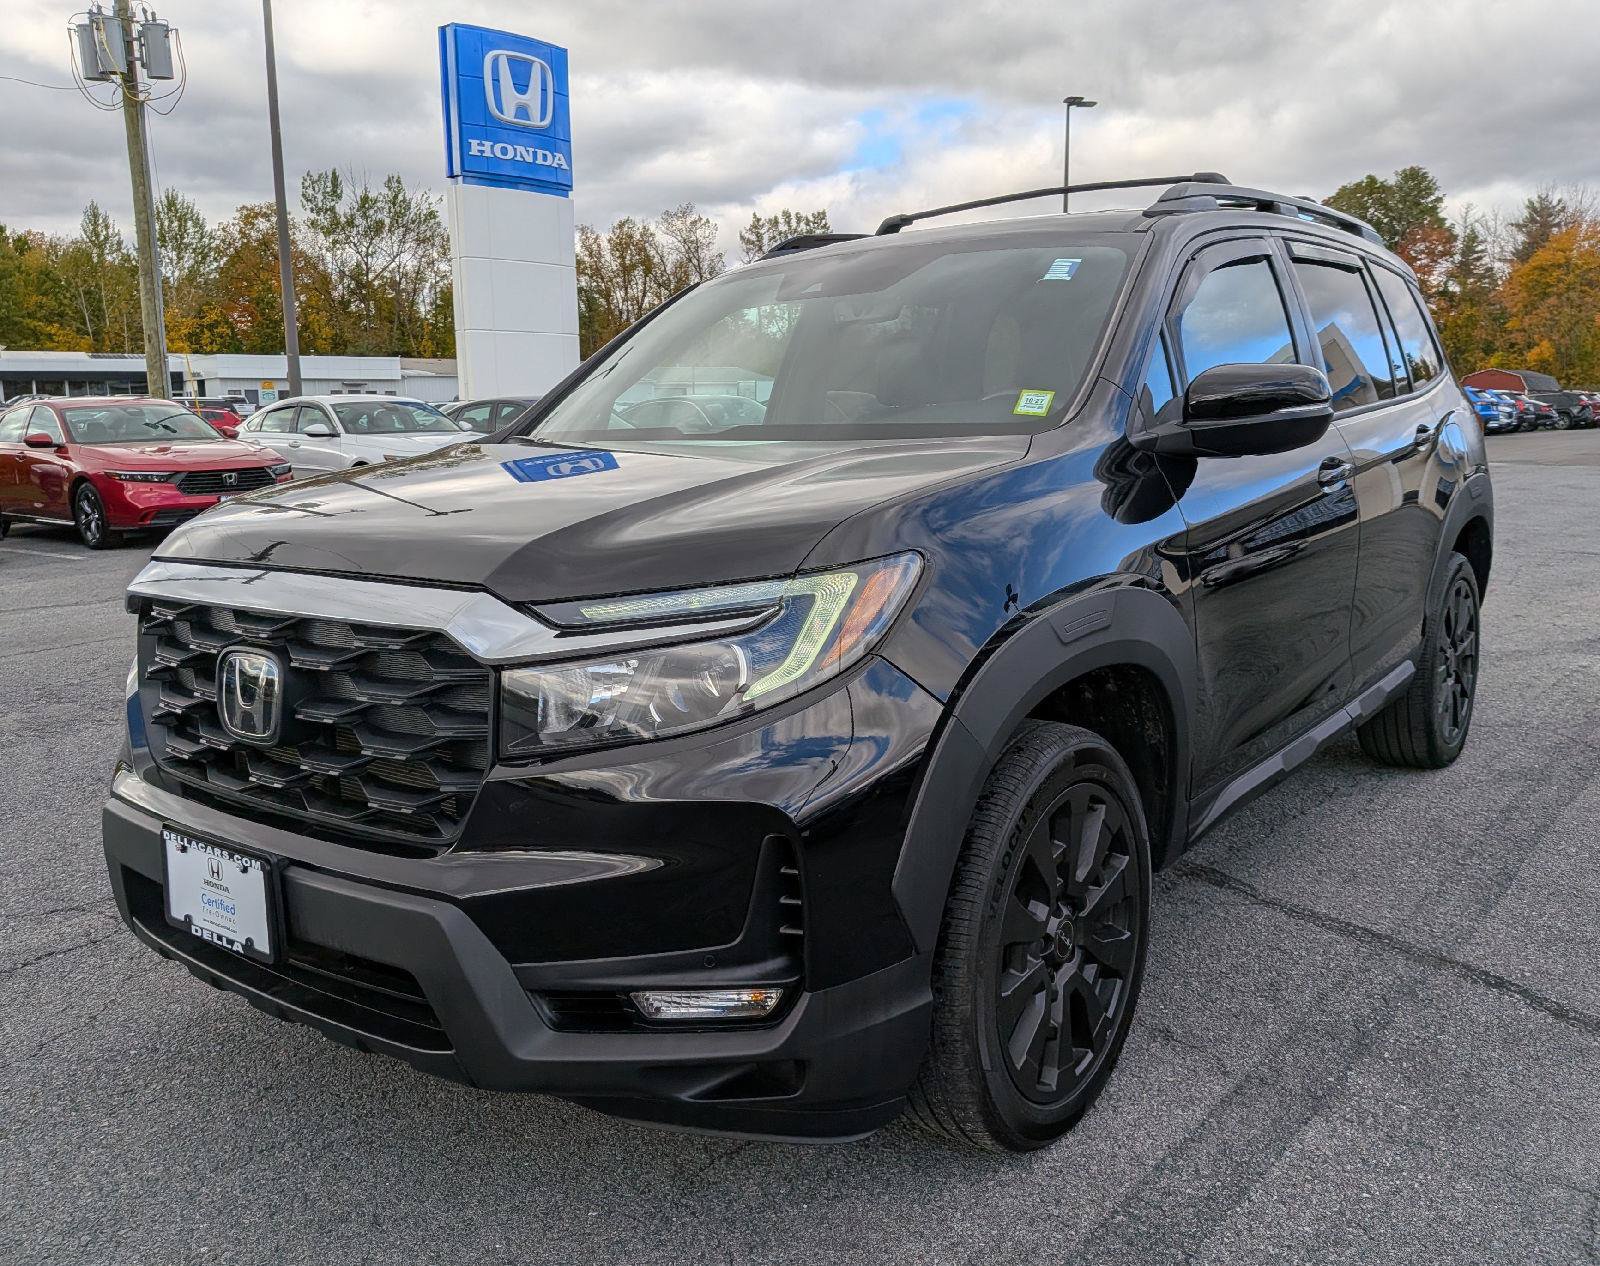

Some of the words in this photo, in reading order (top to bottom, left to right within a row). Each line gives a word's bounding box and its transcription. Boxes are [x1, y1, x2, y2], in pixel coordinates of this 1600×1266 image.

[468, 139, 570, 170] HONDA
[163, 831, 262, 871] DELLACARS.COM
[203, 879, 231, 894] HONDA
[201, 893, 236, 915] Certified
[191, 924, 245, 954] DELLA
